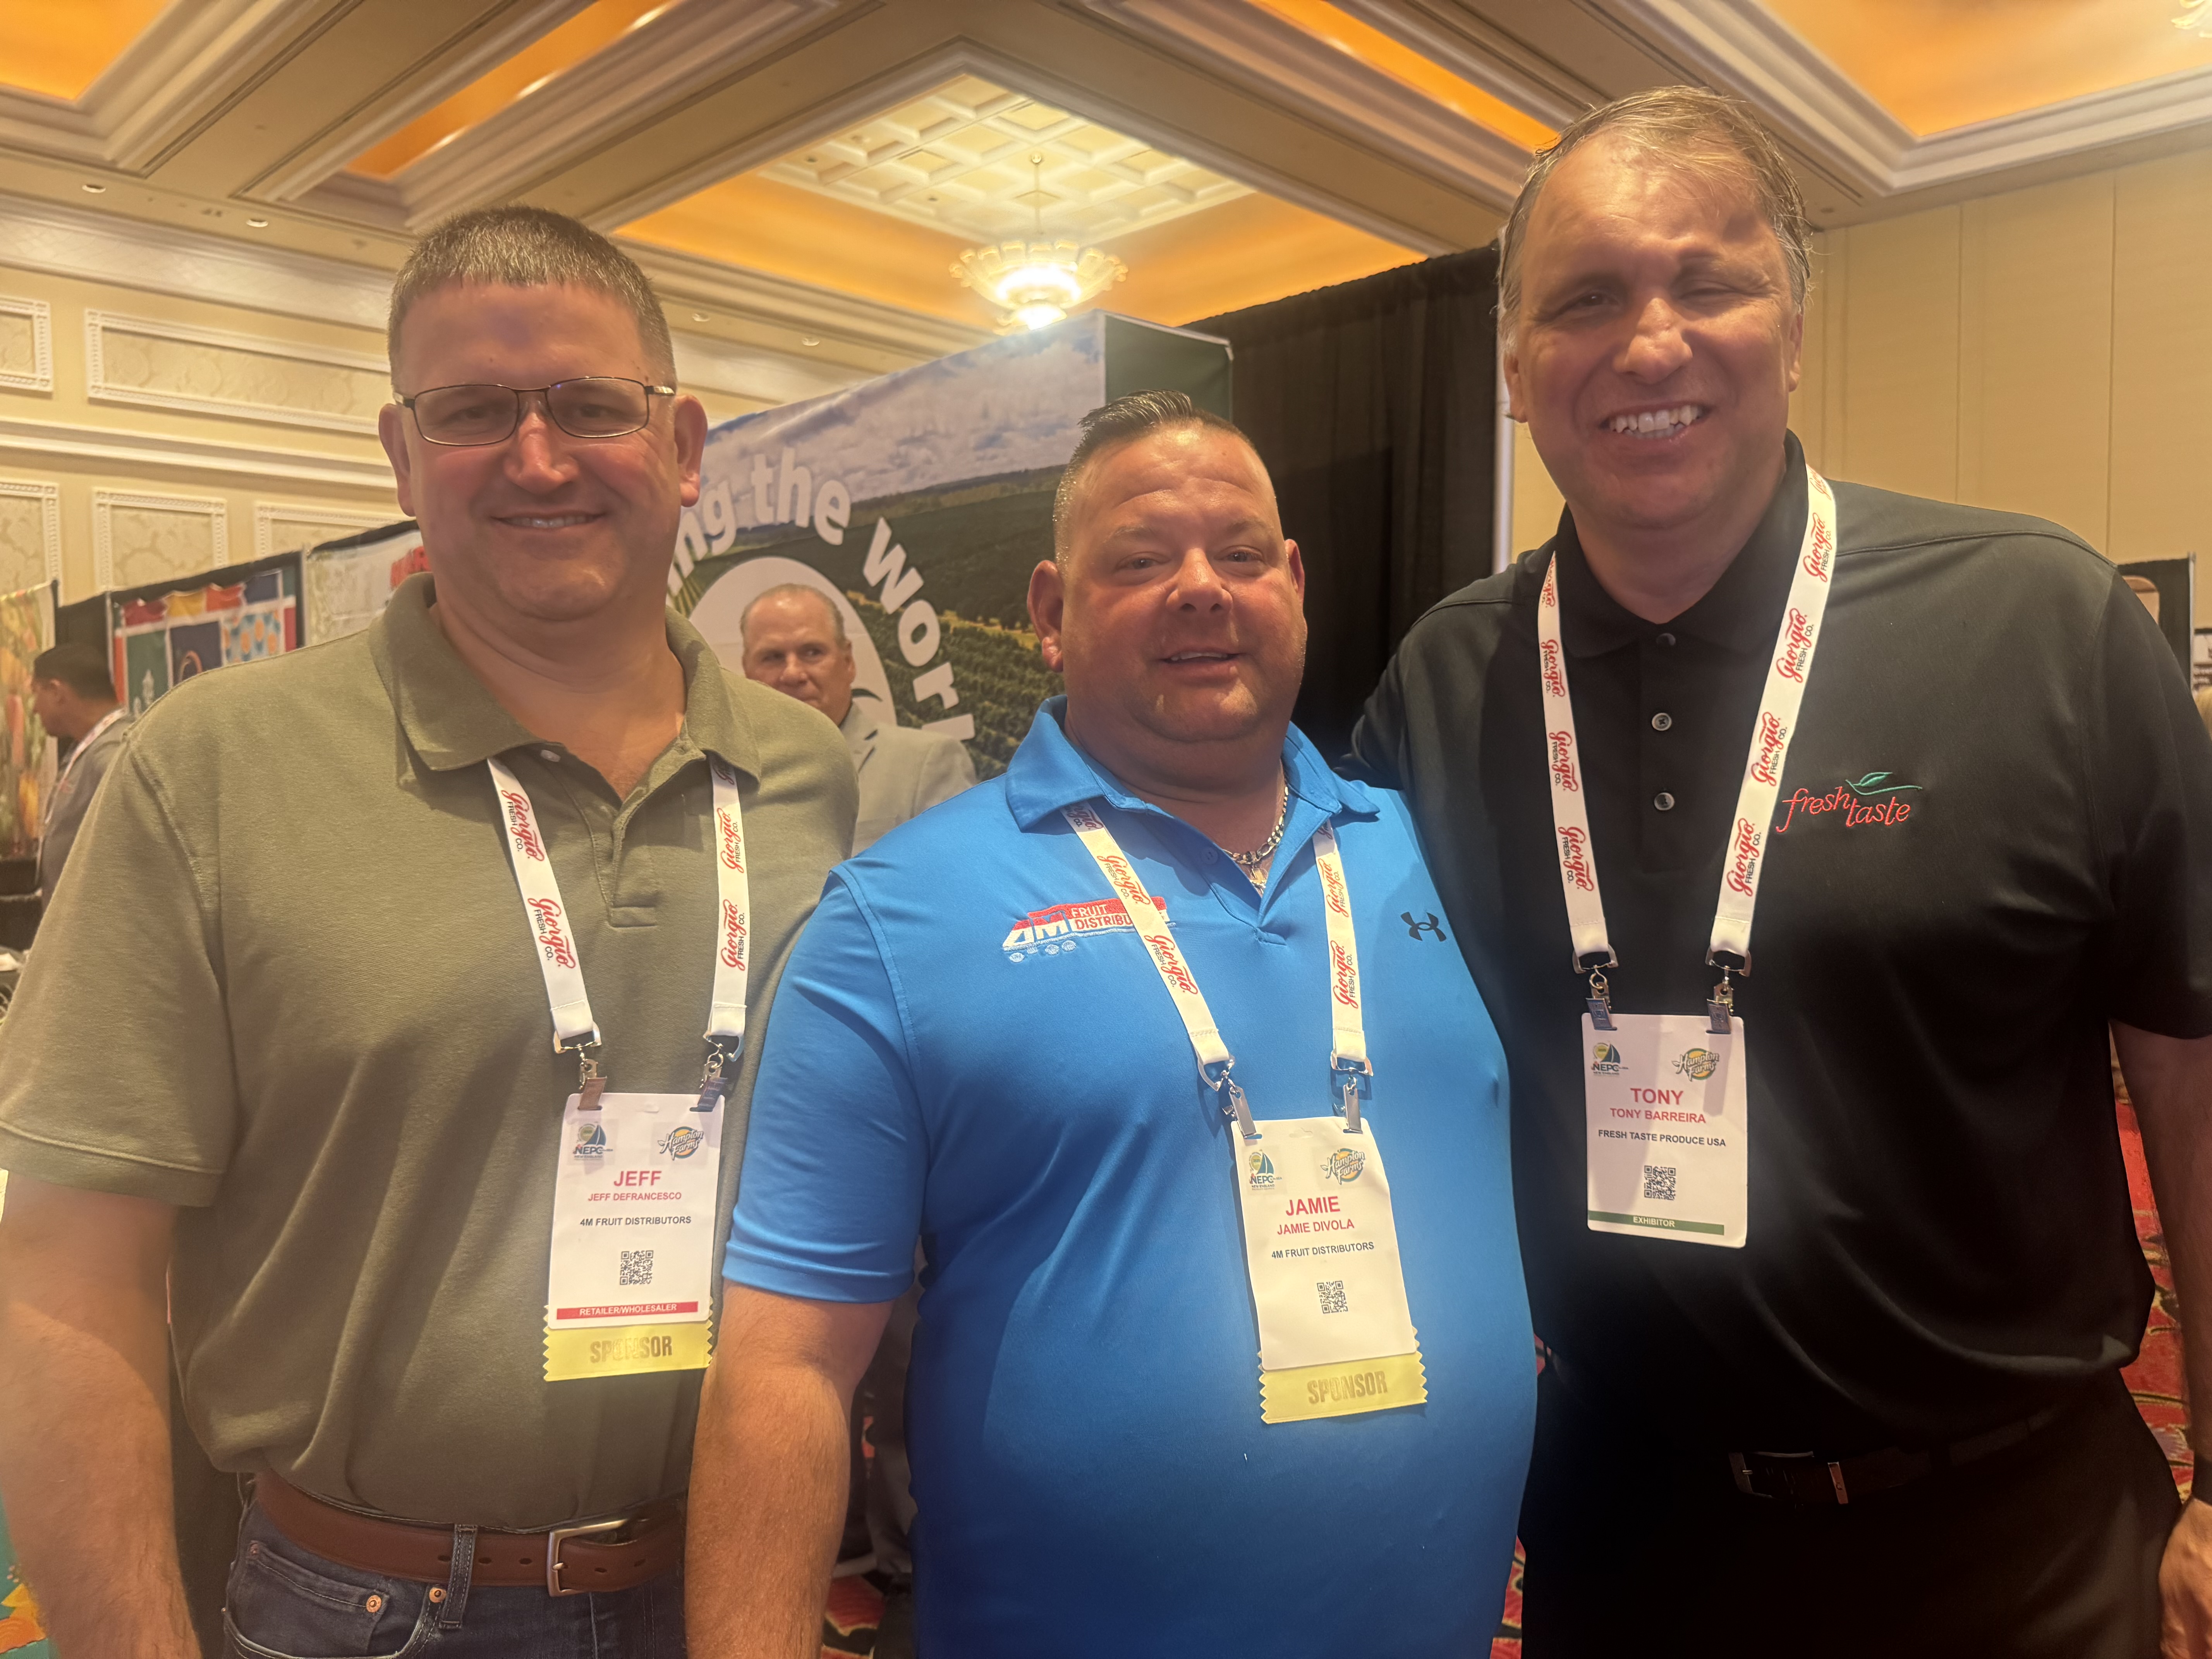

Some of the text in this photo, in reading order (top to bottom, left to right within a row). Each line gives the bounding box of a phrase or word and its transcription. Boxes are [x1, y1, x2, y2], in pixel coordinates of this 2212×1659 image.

[1803, 512, 1832, 583] Giorgio
[1820, 550, 1830, 571] FRESH
[751, 447, 851, 545] the
[863, 517, 975, 741] worl
[1776, 608, 1812, 683] Giorgio
[1541, 639, 1565, 697] Giorgio
[1796, 648, 1807, 672] FRESH
[1549, 731, 1578, 792] Giorgio
[1751, 712, 1784, 787] Giorgio
[1770, 750, 1780, 775] FRESH
[507, 802, 517, 826] FRESH
[1776, 786, 1850, 832] fresh
[1846, 797, 1911, 827] taste
[501, 790, 545, 861] Giorgio
[717, 808, 744, 873] Giorgio
[1562, 837, 1571, 860] FRESH
[1558, 827, 1594, 891] Giorgio
[1727, 818, 1759, 897] Giorgio
[1097, 855, 1151, 905] Giorgio
[1104, 863, 1119, 880] FRESH
[1745, 858, 1756, 883] FRESH
[1318, 858, 1349, 917] Giorgio
[534, 910, 547, 934] FRESH
[1071, 904, 1108, 918] FRUIT
[1075, 914, 1133, 929] DISTRIBU
[528, 898, 576, 969] Giorgio
[721, 899, 747, 971] Giorgio
[1144, 935, 1198, 994] Giorgio
[1152, 945, 1166, 965] FRESH
[1330, 940, 1358, 1009] Giorgio
[1672, 1052, 1720, 1074] Hampton
[1688, 1061, 1717, 1082] Farms
[1630, 1088, 1684, 1105] TONY
[1610, 1108, 1706, 1123] TONY BARREIRA
[574, 1146, 603, 1154] NEPC
[658, 1129, 704, 1154] Hampton
[671, 1140, 699, 1160] Farms
[1598, 1129, 1726, 1147] FRESH TASTE PRODUCE USA
[1321, 1151, 1366, 1179] Hampton
[1336, 1161, 1364, 1185] Farms
[614, 1171, 662, 1187] JEFF
[1250, 1175, 1274, 1184] NEPC
[613, 1192, 682, 1200] DEFRANCESCO
[1286, 1196, 1341, 1216] JAMIE
[580, 1216, 691, 1226] 4M FRUIT DISTRIBUTORS
[1277, 1219, 1355, 1235] JAMIE DIVOLA
[1633, 1216, 1675, 1228] EXHIBITOR
[1272, 1242, 1374, 1259] 4M FRUIT DISTRIBUTORS
[580, 1304, 677, 1316] RETAILER/WHOLESALER
[590, 1336, 672, 1364] SPONSOR
[1307, 1370, 1388, 1404] SPONSOR
